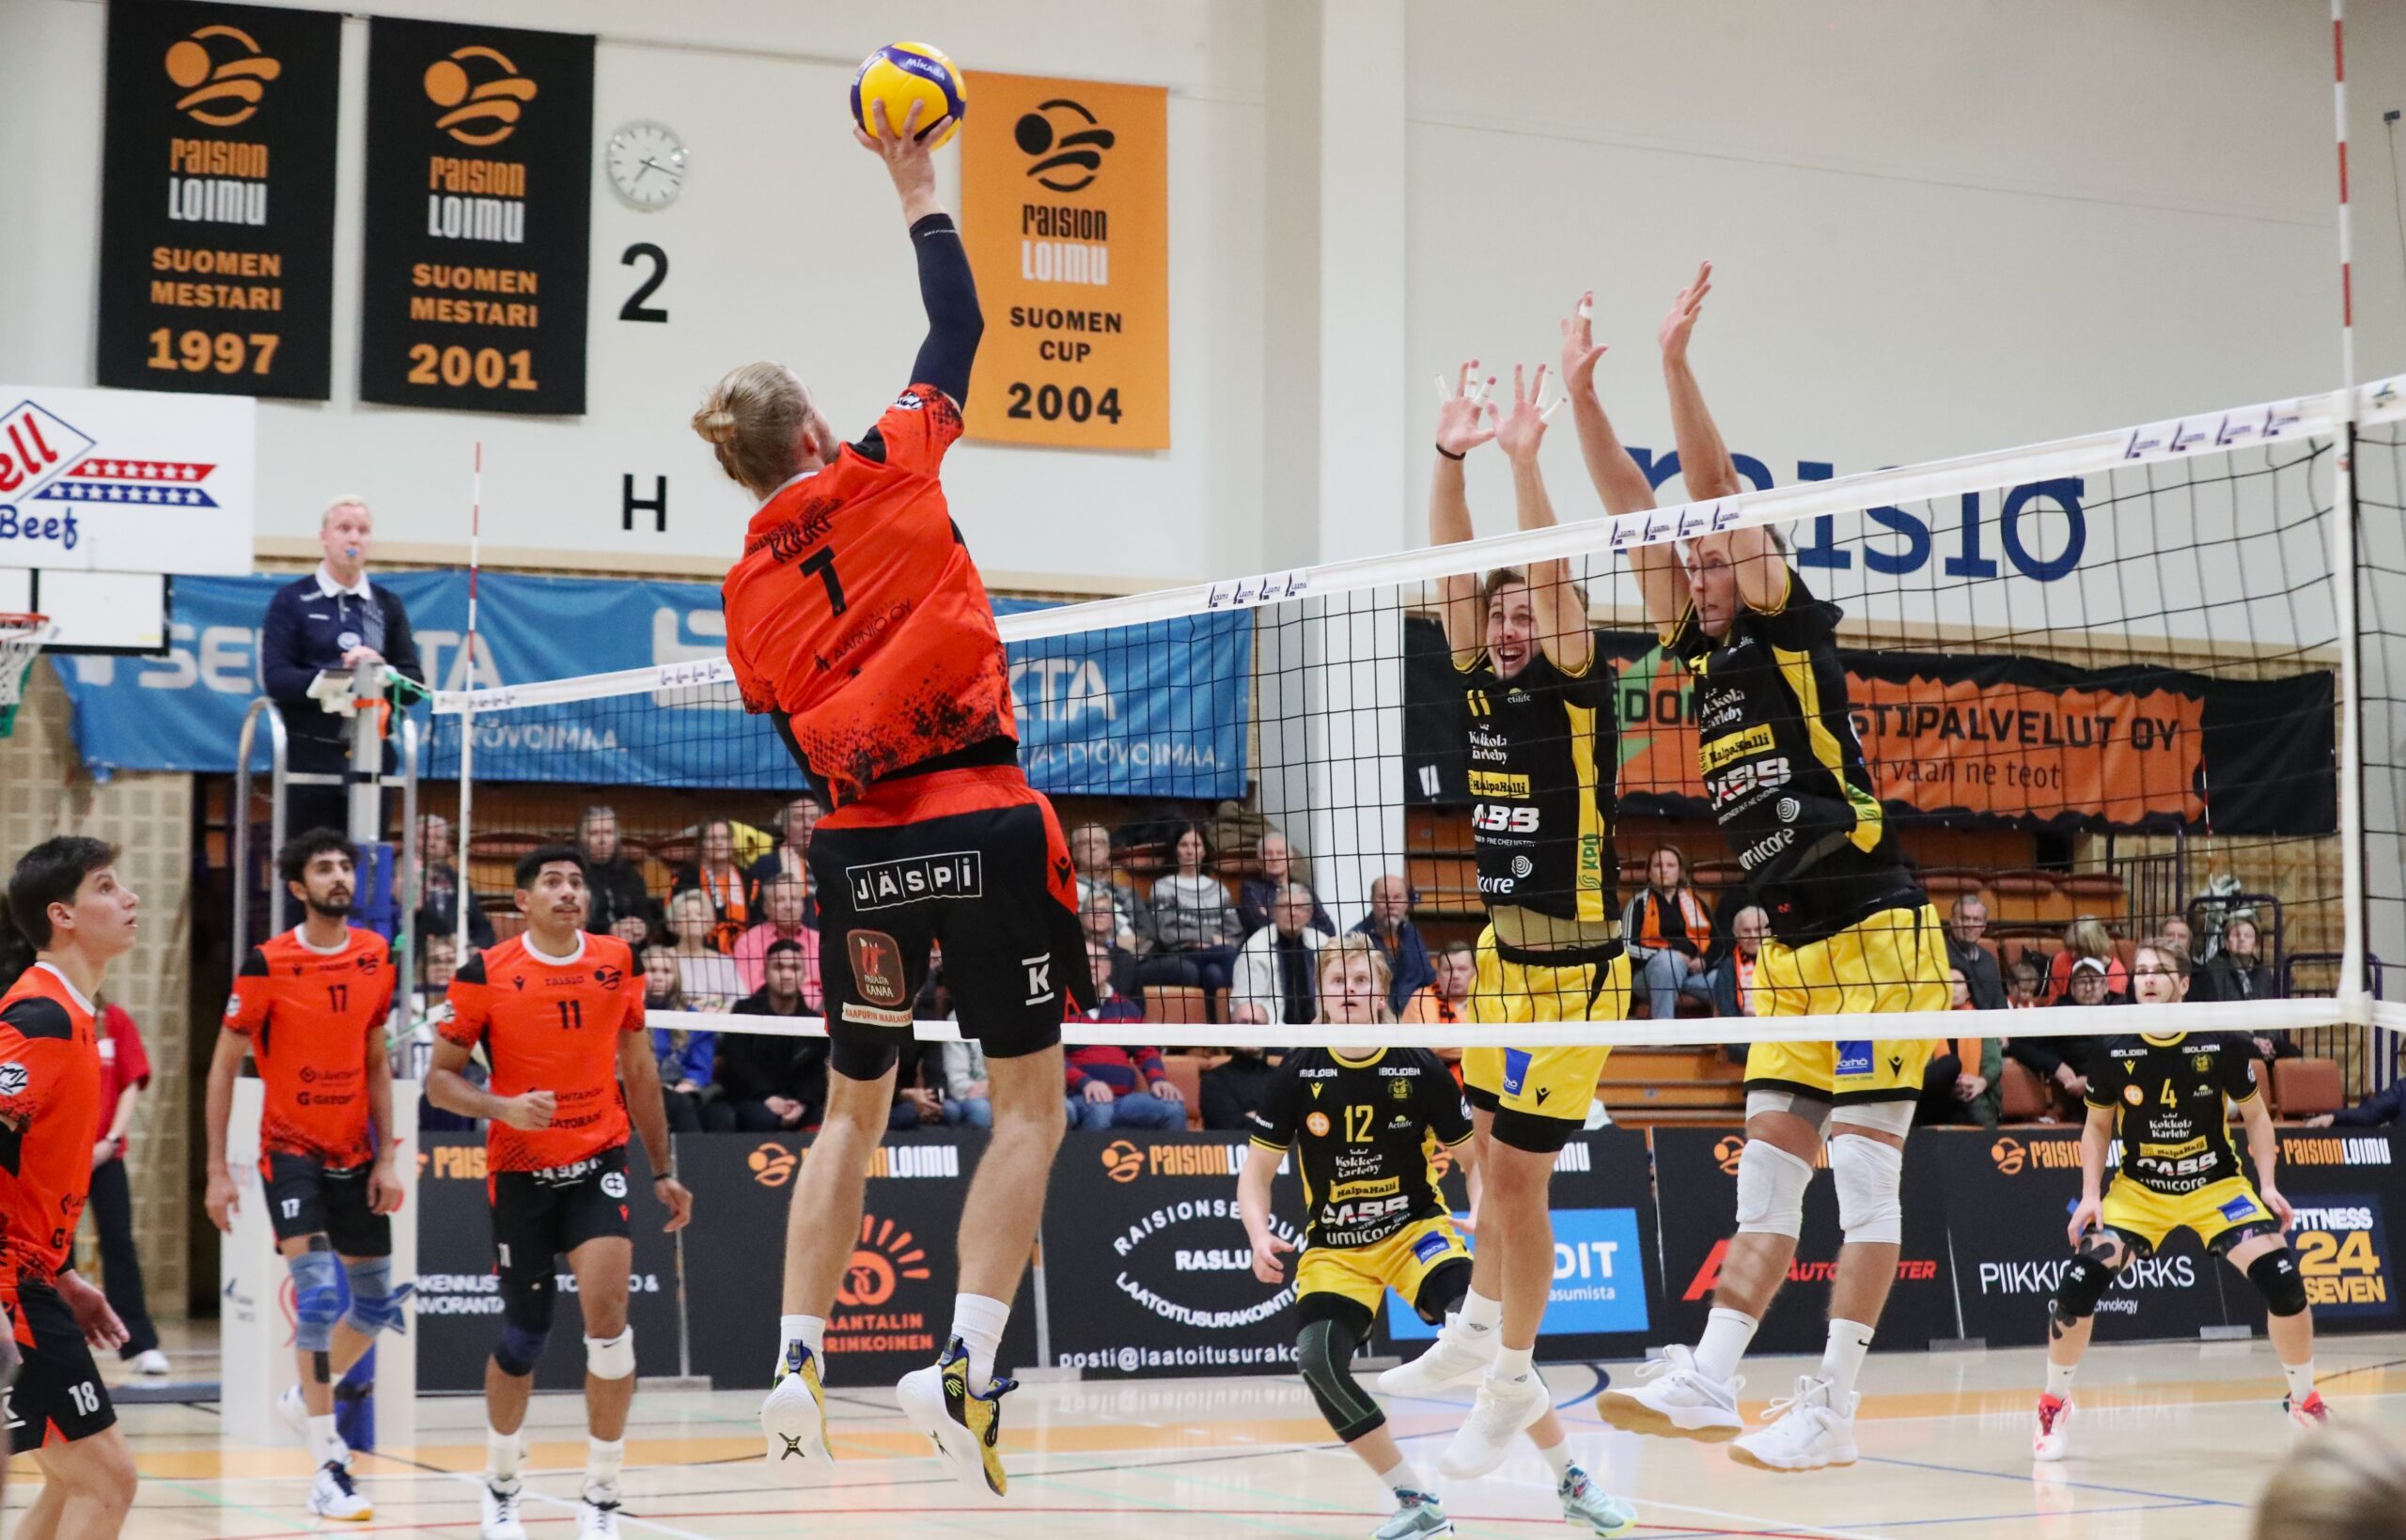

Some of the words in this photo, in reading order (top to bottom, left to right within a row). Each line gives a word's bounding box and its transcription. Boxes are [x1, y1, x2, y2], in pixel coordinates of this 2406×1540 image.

[152, 246, 282, 277] SUOMEN
[413, 263, 538, 295] SUOMEN
[618, 242, 669, 323] 2
[150, 280, 282, 311] MESTARI
[410, 297, 538, 328] MESTARI
[1010, 306, 1122, 334] SUOMEN
[148, 327, 280, 375] 1997
[1039, 340, 1091, 363] CUP
[408, 343, 539, 391] 2001
[1007, 381, 1122, 425] 2004
[622, 474, 668, 532] H
[445, 717, 629, 752] TÖVOIMAA.
[2131, 717, 2180, 751] OY
[1891, 758, 1955, 785] vaan
[1965, 760, 1996, 786] ne
[2007, 759, 2062, 790] teot
[1472, 803, 1539, 833] ABB
[1582, 833, 1600, 870] KPO
[857, 857, 972, 900] JÄSPI
[327, 984, 348, 1013] 17
[866, 984, 894, 998] KANAA
[557, 1000, 581, 1030] 11
[2112, 1048, 2148, 1057] BOLIDEN
[2183, 1044, 2220, 1053] BOLIDEN
[1381, 1066, 1420, 1077] BOLIDEN
[2160, 1078, 2178, 1109] 4
[1344, 1104, 1374, 1143] 12
[1388, 1119, 1413, 1129] Actilife
[281, 1198, 300, 1219] 17
[2291, 1207, 2374, 1232] FITNESS
[2295, 1230, 2381, 1277] 24
[2109, 1255, 2195, 1290] ORKS
[2304, 1275, 2387, 1305] SEVEN
[826, 1313, 924, 1330] AANTALIN
[823, 1334, 933, 1352] RINKOINEN
[68, 1380, 101, 1417] 18
